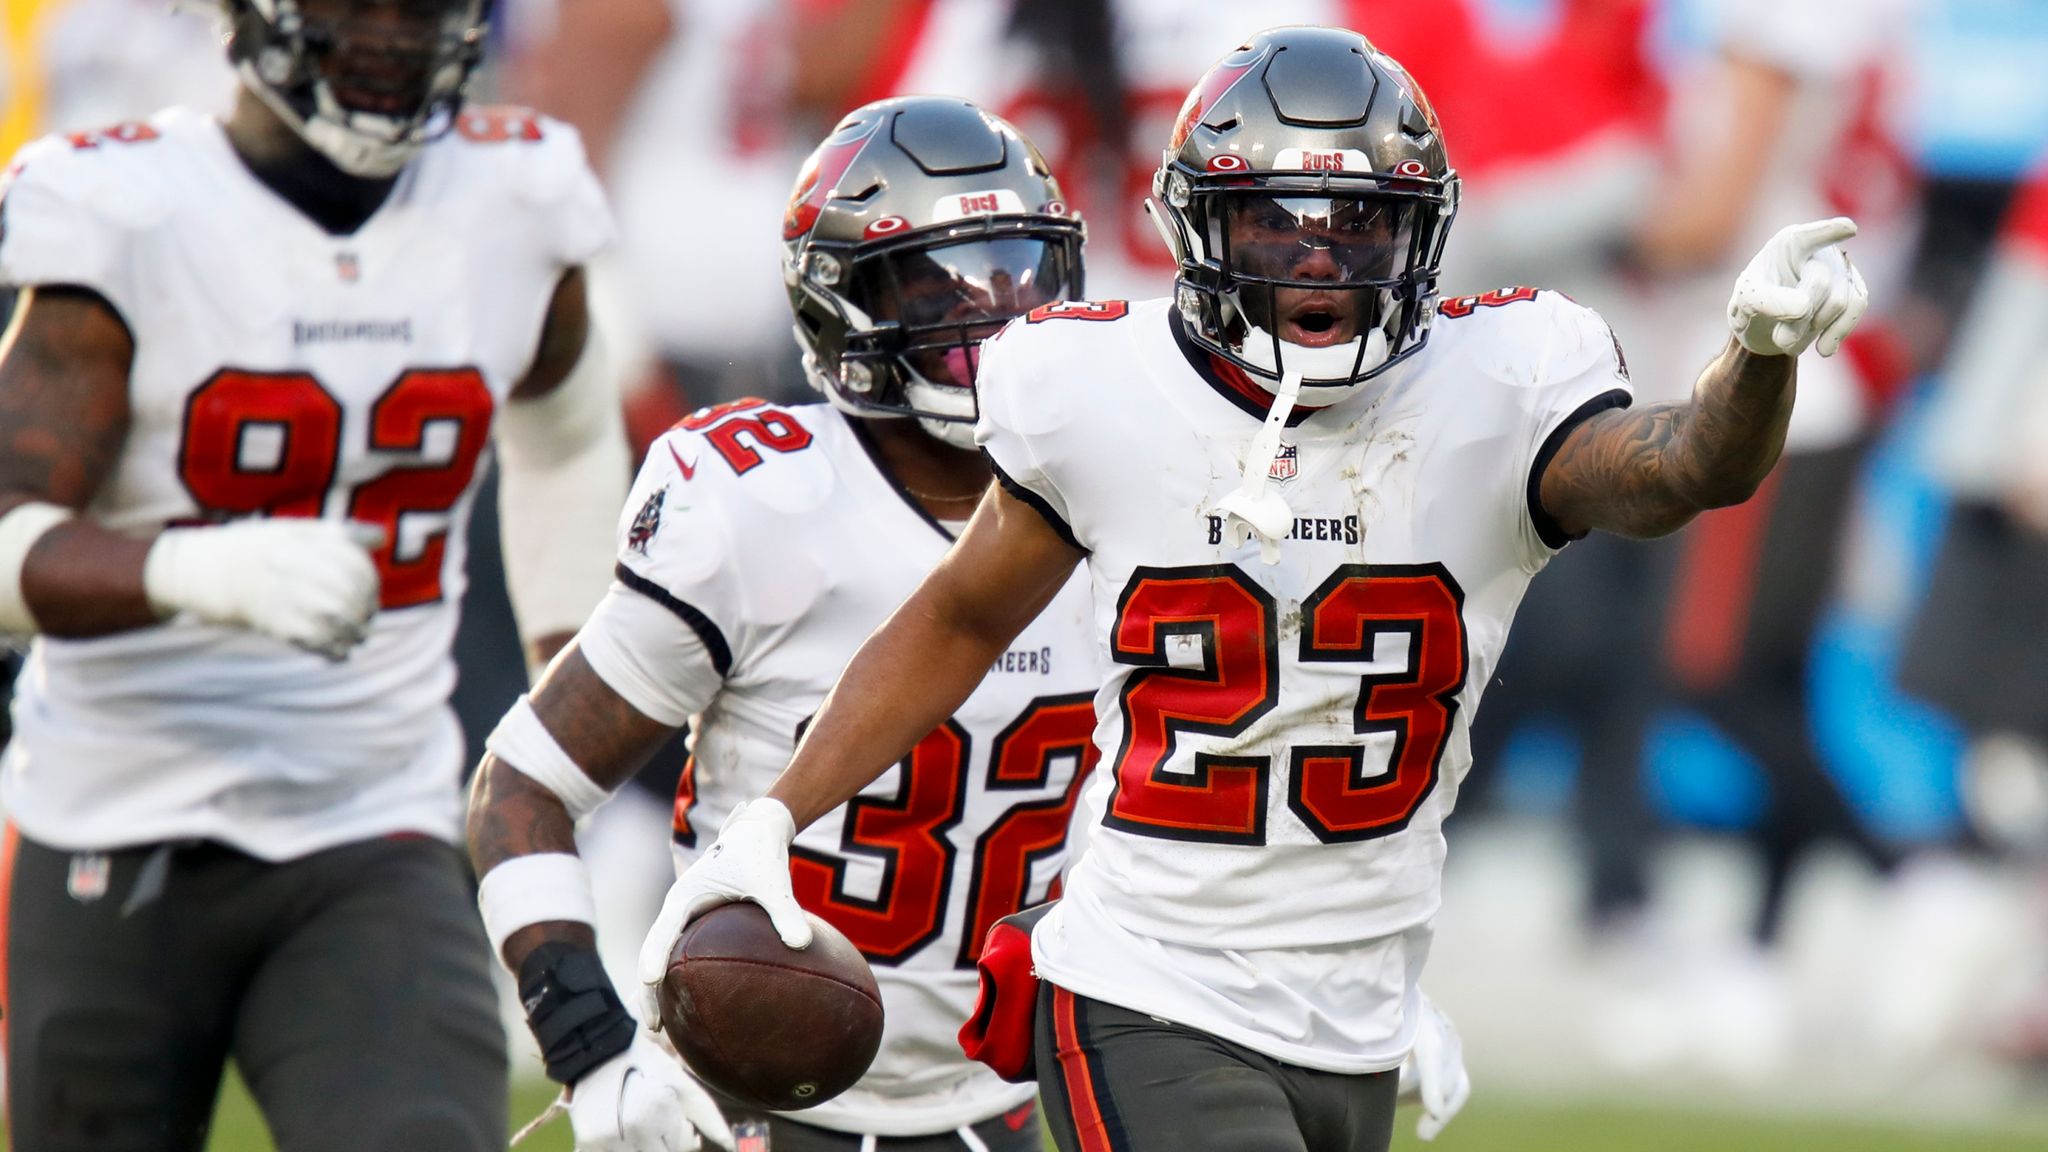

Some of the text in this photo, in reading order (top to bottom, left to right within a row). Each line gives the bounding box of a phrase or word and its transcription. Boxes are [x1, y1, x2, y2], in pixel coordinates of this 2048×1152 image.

[1302, 152, 1345, 172] BUCS
[165, 366, 495, 612] 92
[789, 690, 1103, 970] 32
[1101, 561, 1470, 847] 23
